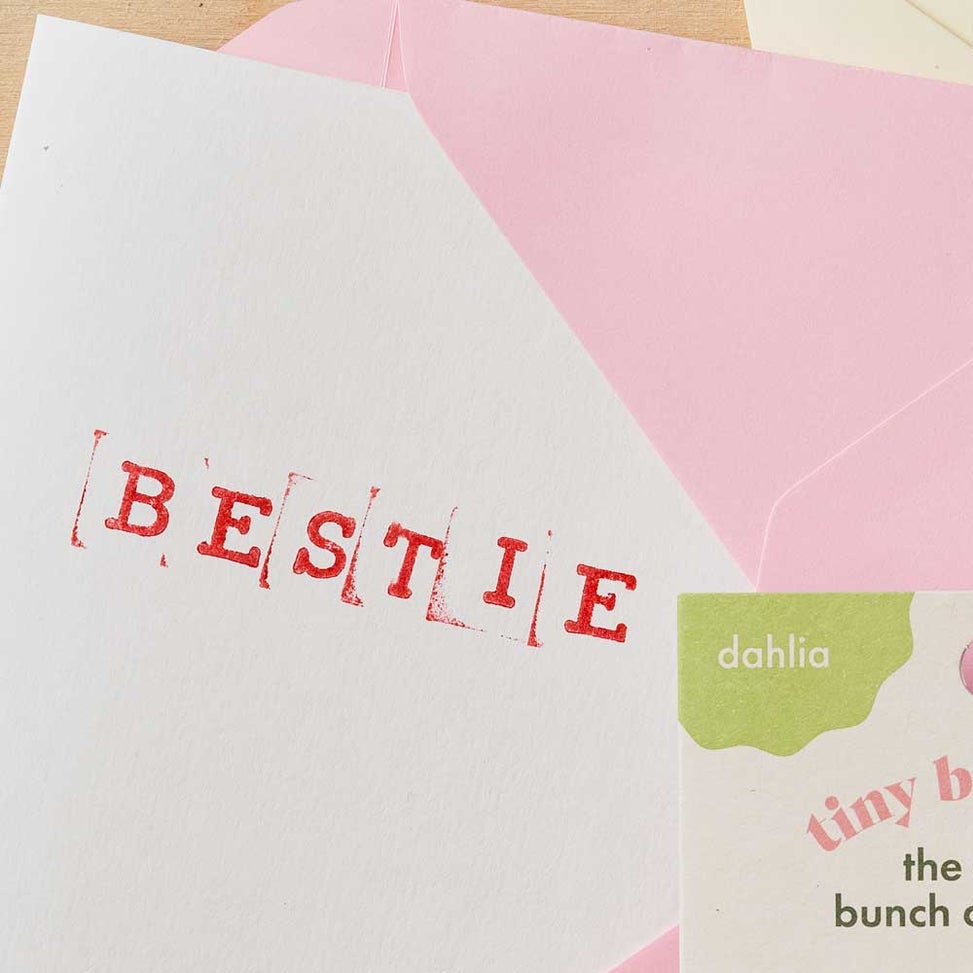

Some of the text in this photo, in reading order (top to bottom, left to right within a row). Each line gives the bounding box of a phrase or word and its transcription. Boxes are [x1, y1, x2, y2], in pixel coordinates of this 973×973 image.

[104, 460, 638, 643] BESTIE
[717, 634, 830, 670] dahlia
[806, 777, 917, 852] tiny
[903, 847, 962, 882] the
[835, 893, 950, 928] bunch
